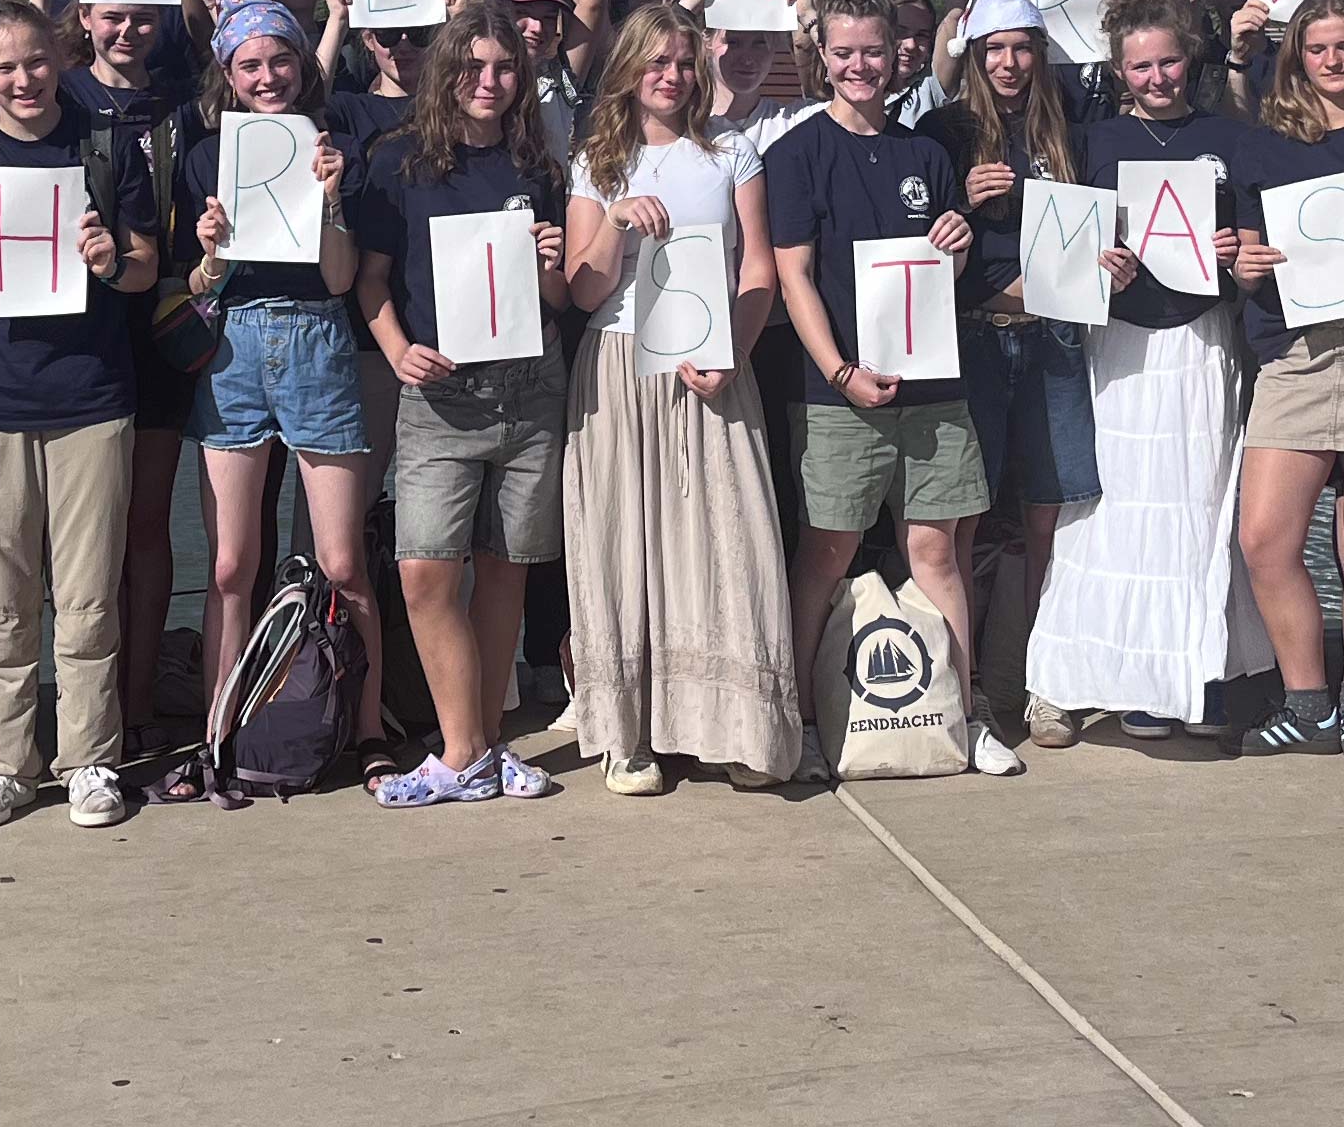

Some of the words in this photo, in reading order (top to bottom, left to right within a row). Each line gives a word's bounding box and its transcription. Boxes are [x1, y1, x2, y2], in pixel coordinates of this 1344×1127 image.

[232, 118, 301, 248] R
[640, 234, 713, 357] S
[871, 258, 941, 356] T
[1024, 193, 1106, 304] M
[1138, 179, 1211, 283] A
[850, 713, 943, 733] EENDRACHT
